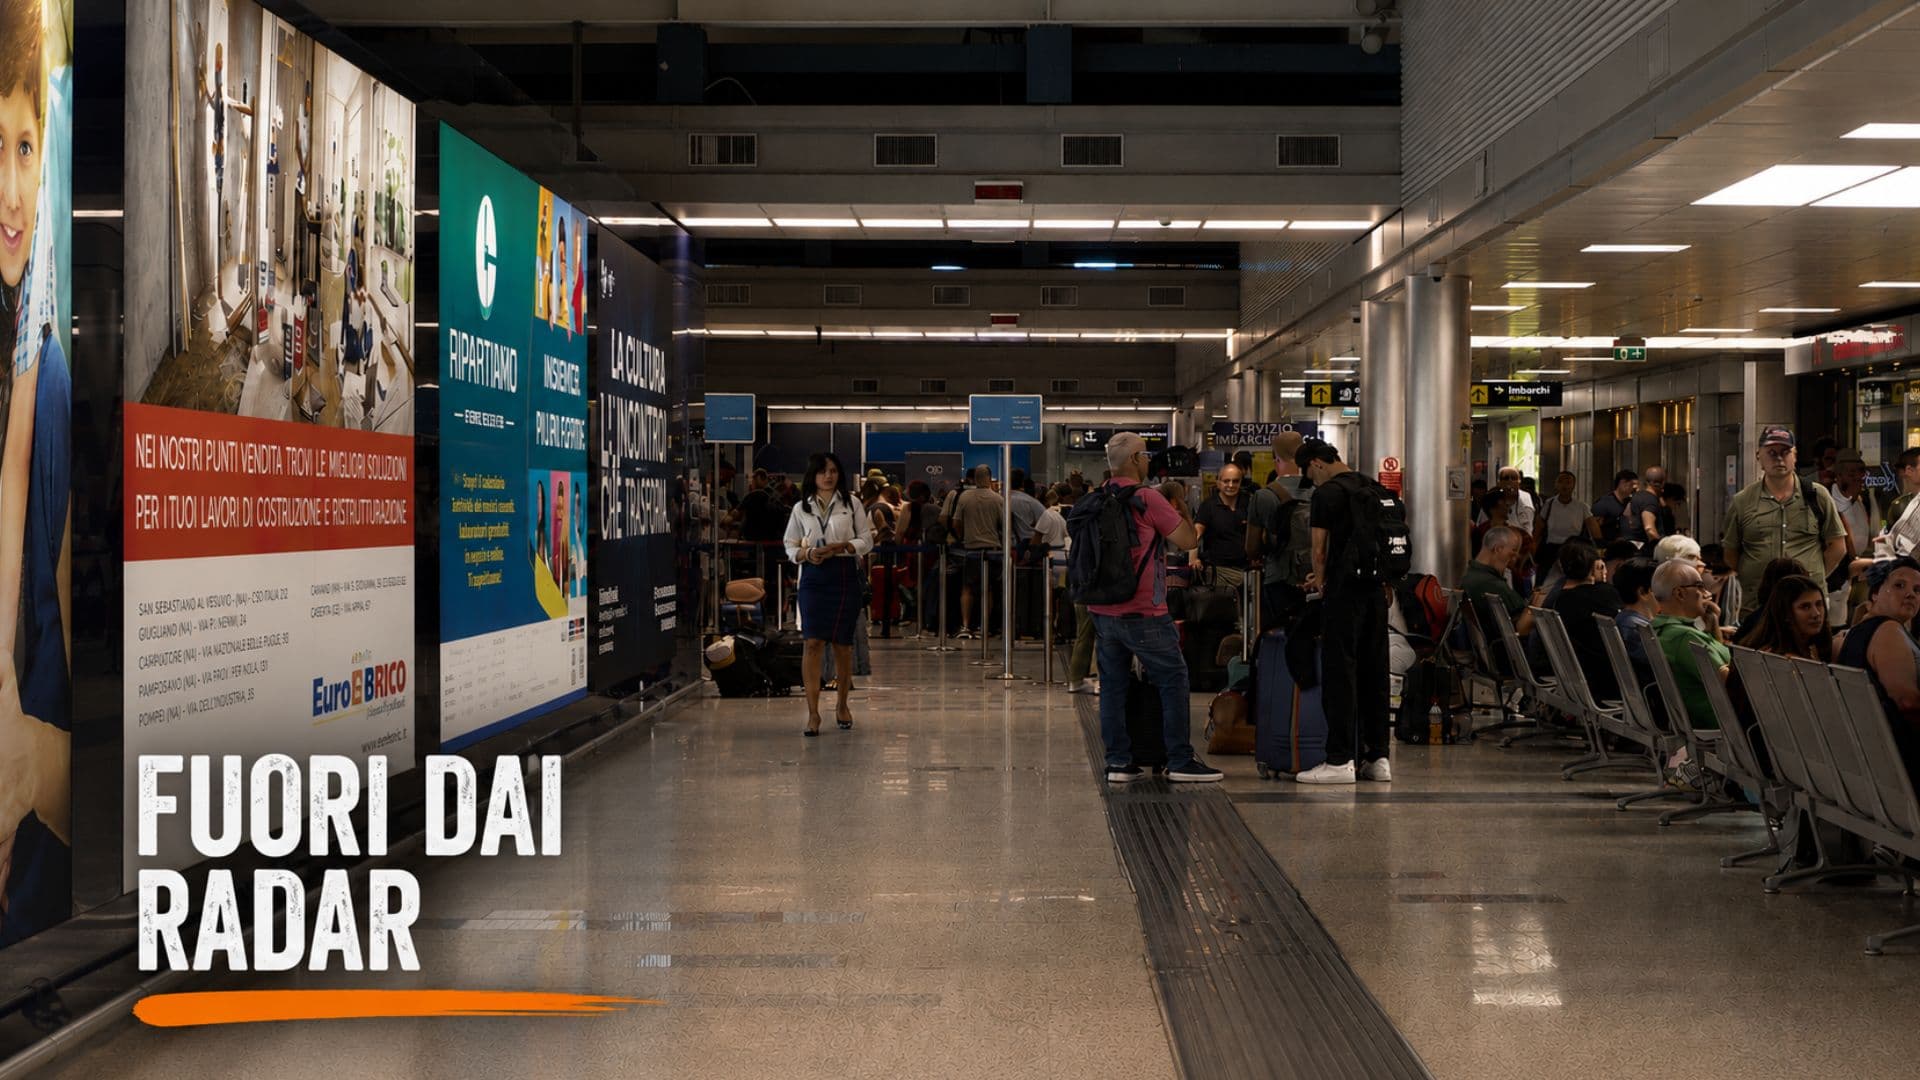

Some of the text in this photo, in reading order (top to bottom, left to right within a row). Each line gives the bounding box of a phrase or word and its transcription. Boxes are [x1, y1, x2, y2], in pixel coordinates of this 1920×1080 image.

[450, 328, 517, 393] RIPARTIAMO
[611, 328, 666, 395] LA CULTURA
[1216, 434, 1273, 446] IMBARCH
[1233, 424, 1293, 434] SERVIZIO
[136, 433, 407, 482] NEI NOSTRI PUNTI VENDITA TROVI LE MIGLIORI SOLUZIONI
[136, 494, 159, 530] PER
[168, 495, 197, 529] TUOI
[201, 496, 240, 528] LAVORI
[243, 496, 253, 528] DI
[256, 497, 321, 528] COSTRUZIONE
[324, 498, 330, 526] E
[332, 499, 407, 526] RISTRUTTURAZIONE
[138, 600, 153, 616] SAN
[155, 597, 196, 615] SEBASTIANO
